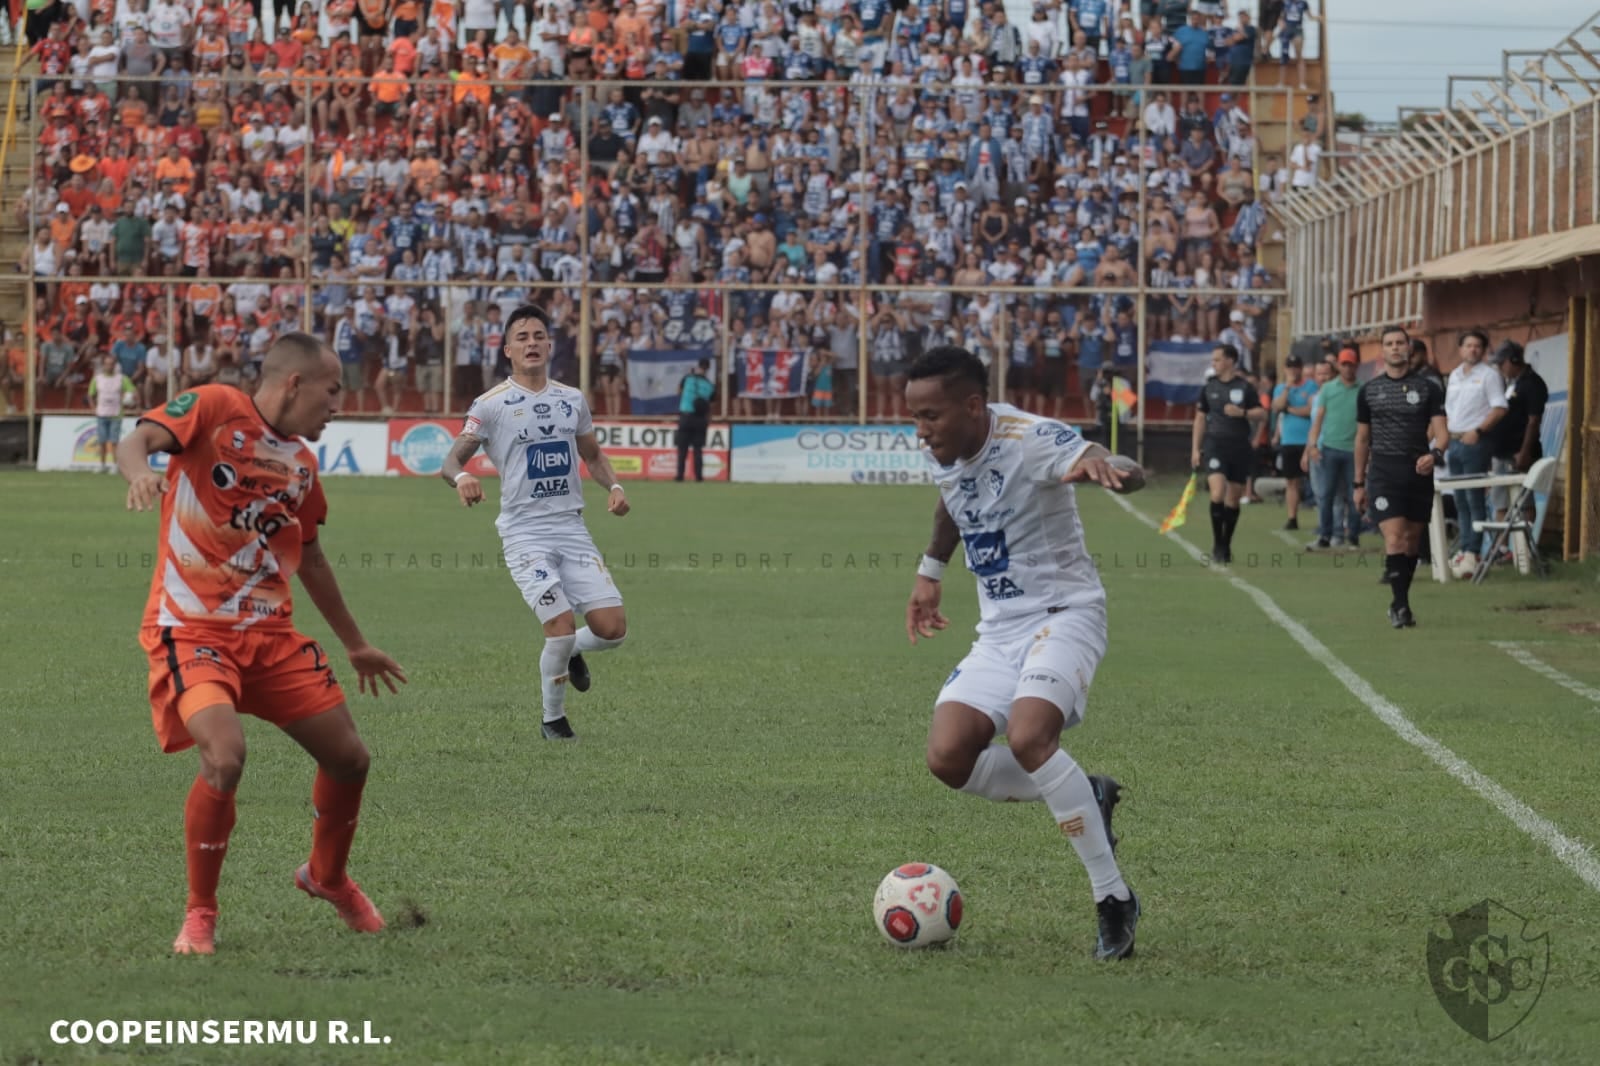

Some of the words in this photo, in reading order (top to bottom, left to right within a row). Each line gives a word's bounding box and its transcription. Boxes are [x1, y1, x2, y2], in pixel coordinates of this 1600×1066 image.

[594, 427, 622, 446] DE
[629, 428, 725, 448] LOTA
[807, 452, 929, 469] DISTRIBU
[533, 478, 569, 493] ALFA
